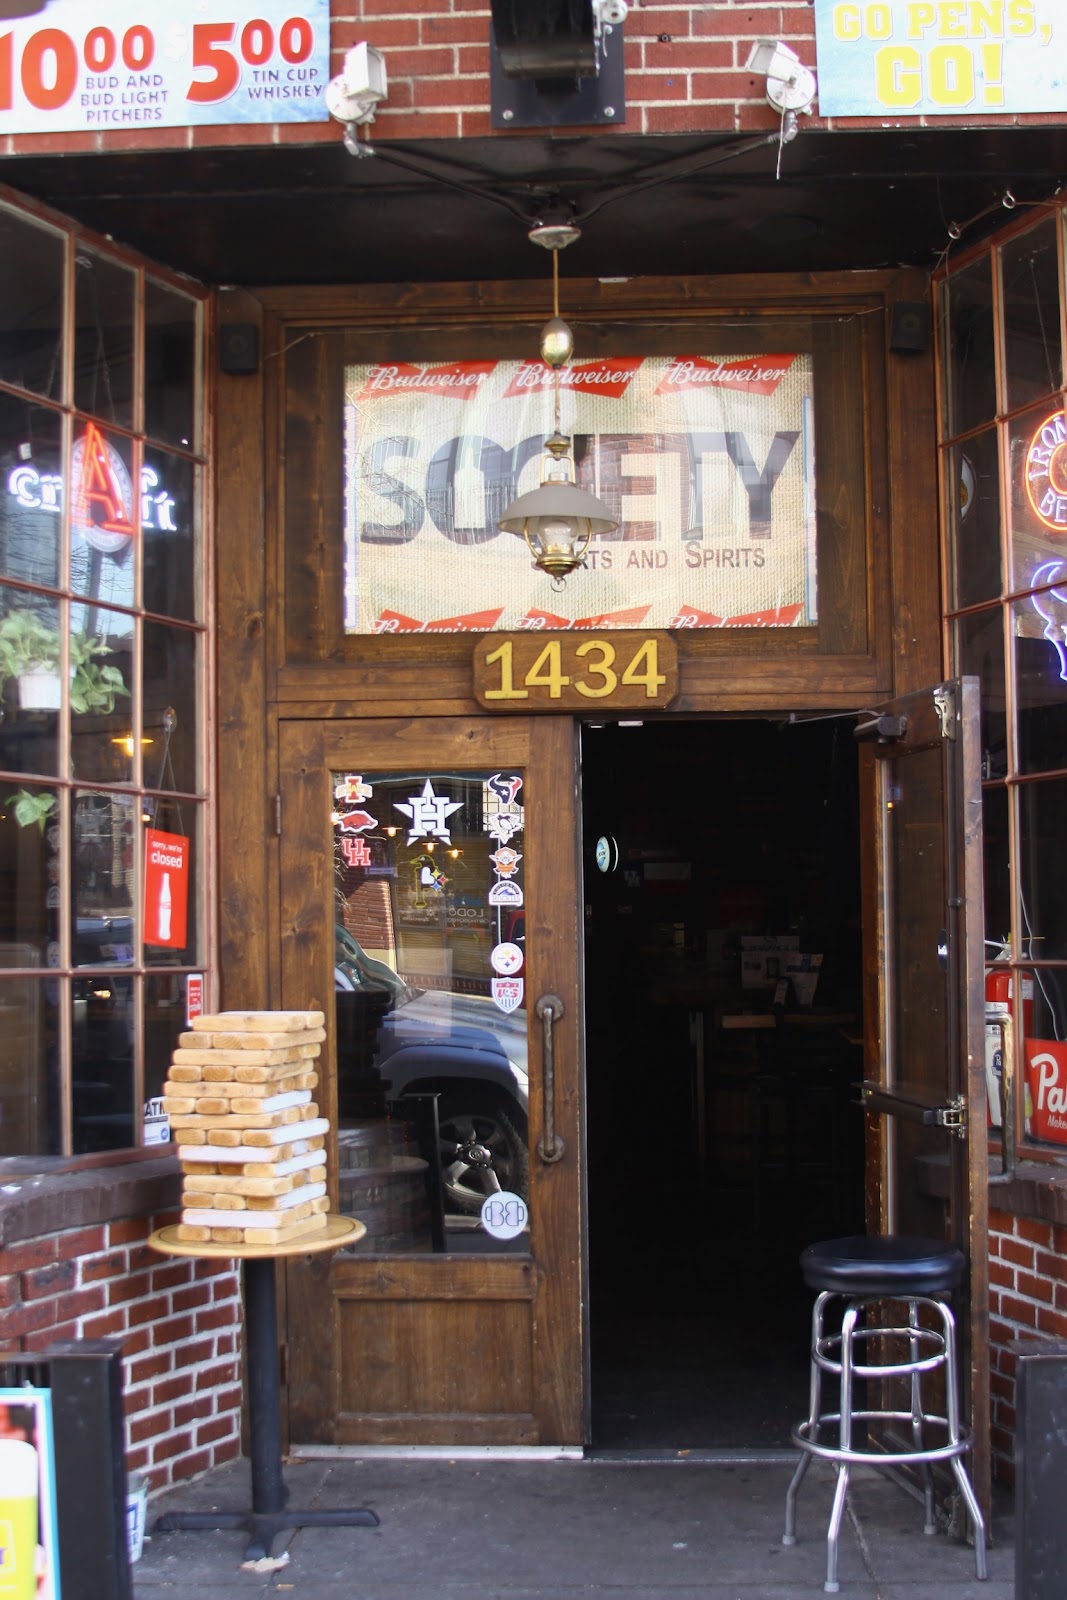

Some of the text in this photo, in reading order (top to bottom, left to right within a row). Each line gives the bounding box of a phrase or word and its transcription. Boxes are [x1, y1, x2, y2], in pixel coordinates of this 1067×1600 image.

[833, 0, 1053, 45] GO PENS,
[86, 74, 163, 90] BUD AND
[252, 68, 319, 83] TIN CUP
[874, 43, 1005, 108] GO!
[81, 91, 169, 107] BUD LIGHT
[247, 84, 325, 99] WHISKEY
[86, 108, 163, 123] PITCHERS
[366, 366, 489, 389] Budweiser
[513, 363, 636, 387] Budweiser
[663, 360, 786, 384] Budweiser
[627, 549, 668, 569] AND
[484, 639, 666, 699] 1434
[151, 851, 182, 868] closed
[1031, 1053, 1067, 1114] Pa
